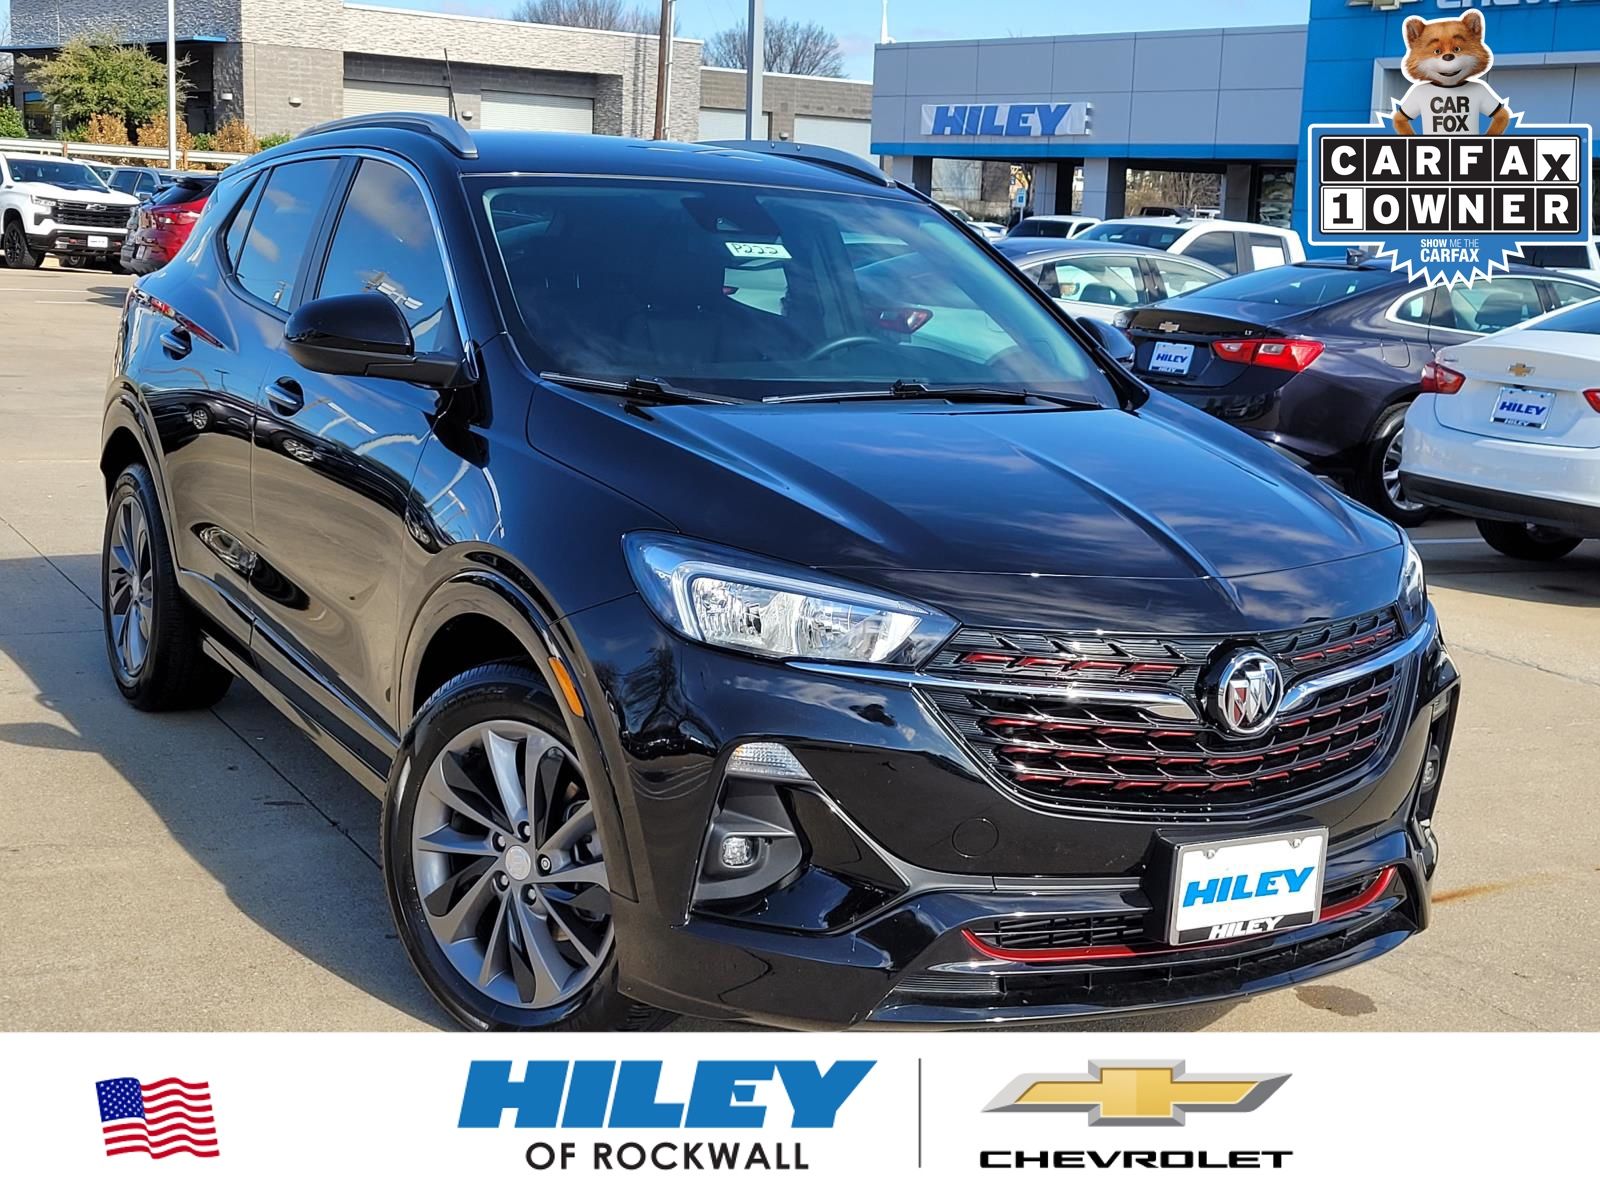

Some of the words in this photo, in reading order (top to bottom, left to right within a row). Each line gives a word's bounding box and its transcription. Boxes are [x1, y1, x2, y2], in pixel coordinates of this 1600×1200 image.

[932, 104, 1072, 136] HILEY
[1155, 352, 1188, 364] HILEY
[1499, 401, 1546, 415] HILEY
[1182, 866, 1315, 908] HILEY
[1208, 915, 1285, 940] HILEY
